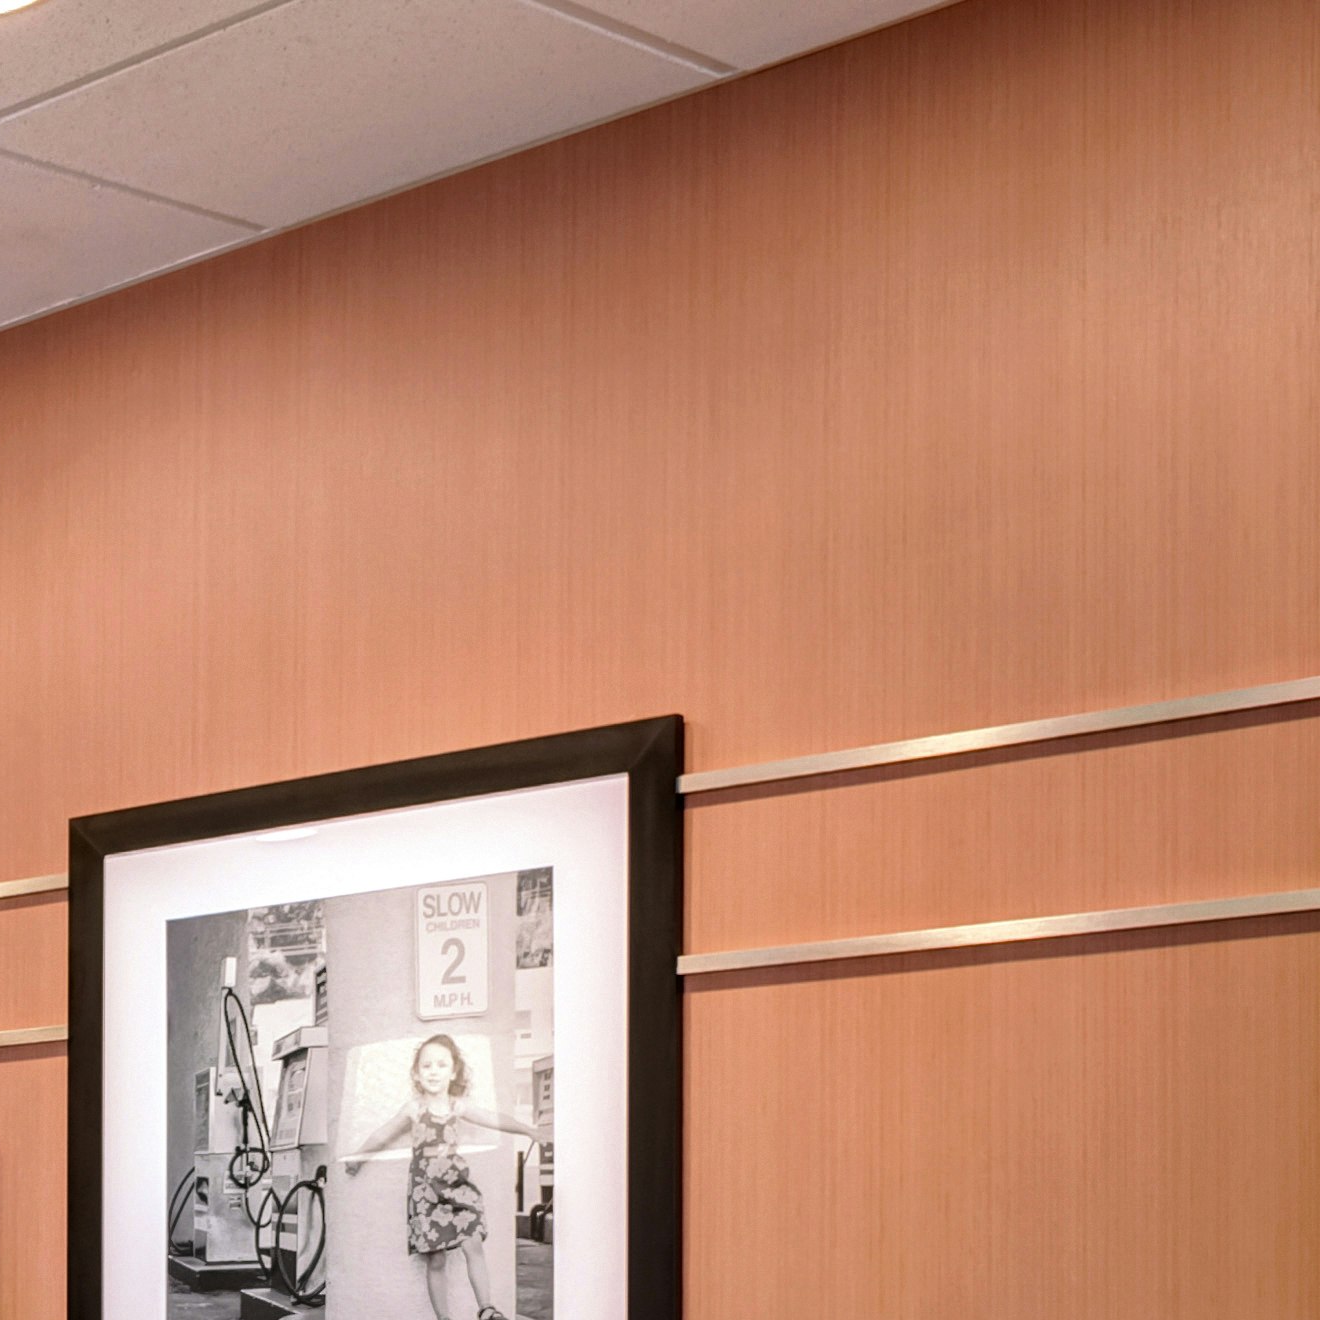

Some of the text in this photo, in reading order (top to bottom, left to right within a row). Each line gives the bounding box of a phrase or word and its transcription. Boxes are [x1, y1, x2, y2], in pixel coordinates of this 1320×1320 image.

[422, 891, 482, 918] SLOW
[425, 919, 480, 932] CHILDREN
[440, 937, 467, 985] 2
[433, 992, 474, 1008] M.PH.
